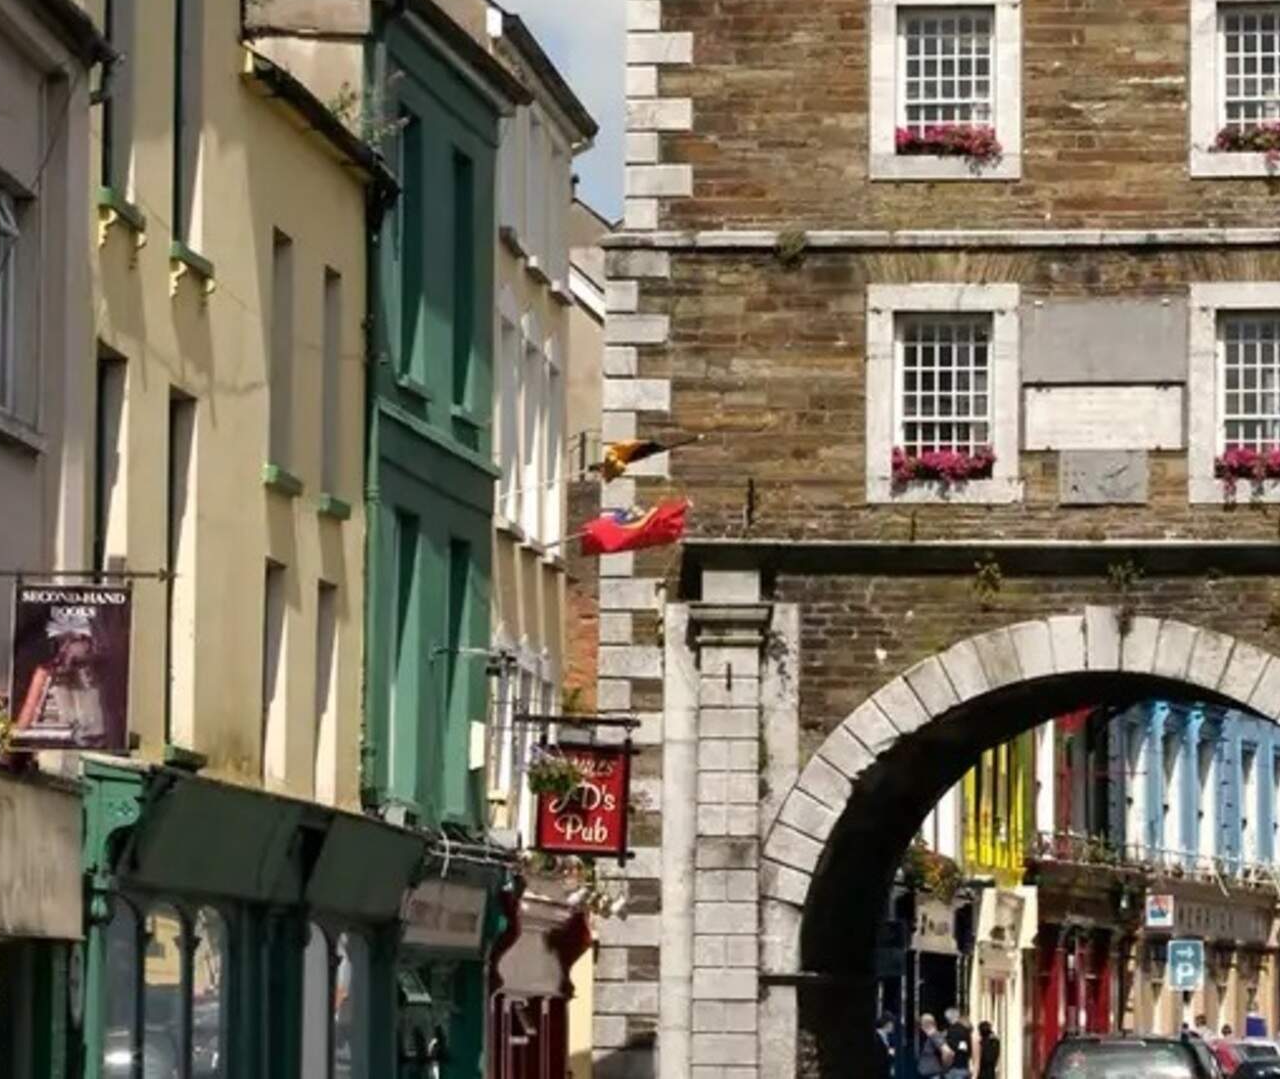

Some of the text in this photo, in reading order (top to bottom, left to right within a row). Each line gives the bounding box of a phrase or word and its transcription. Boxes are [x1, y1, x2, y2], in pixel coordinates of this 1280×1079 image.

[51, 605, 96, 618] BOOKS
[554, 814, 609, 843] Pub
[1176, 963, 1194, 984] P
